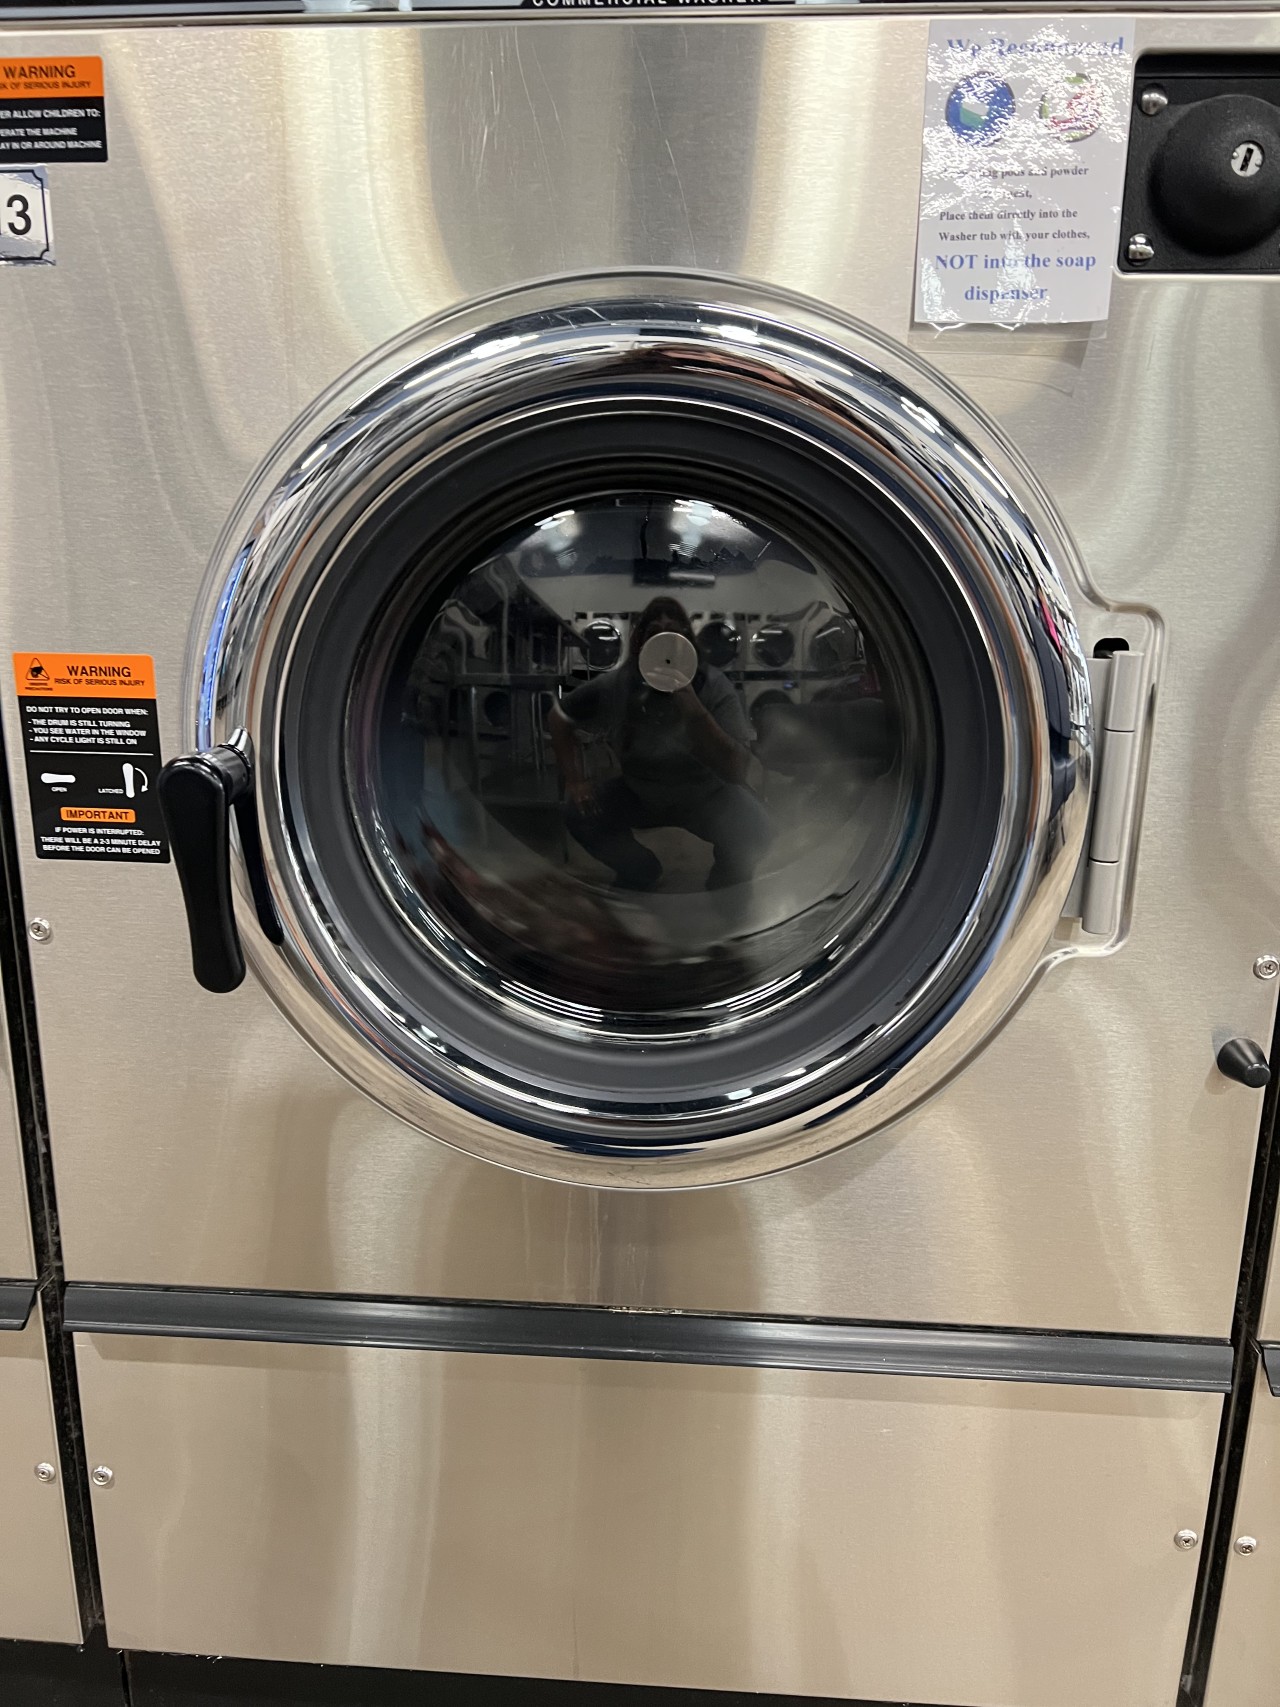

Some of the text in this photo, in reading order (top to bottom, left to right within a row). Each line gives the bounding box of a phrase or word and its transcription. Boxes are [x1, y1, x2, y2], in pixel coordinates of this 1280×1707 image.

[3, 65, 76, 78] WARNING
[10, 81, 20, 89] OF
[24, 81, 60, 89] SERIOUS
[62, 80, 91, 88] INJURY
[13, 110, 41, 118] ALLOW
[43, 109, 85, 118] CHILDREN
[86, 108, 101, 117] TO:
[26, 128, 41, 136] THE
[42, 127, 78, 136] MACHINE
[11, 141, 20, 149] IN
[21, 141, 32, 149] OR
[33, 140, 66, 149] AROUND
[67, 140, 103, 148] MACHINE
[1050, 165, 1089, 178] powder
[939, 208, 1078, 221] Place them directly into the
[938, 231, 978, 241] Washer
[980, 230, 997, 240] tub
[1025, 231, 1050, 243] your
[1052, 229, 1090, 240] clothes,
[935, 254, 978, 270] NOT
[1024, 253, 1051, 268] the
[1056, 254, 1096, 271] soap
[964, 285, 1048, 305] dispenser
[67, 665, 131, 678] WARNING
[119, 679, 145, 687] INJURY
[66, 810, 129, 820] IMPORTANT
[96, 828, 144, 836] INTERRUPTED:
